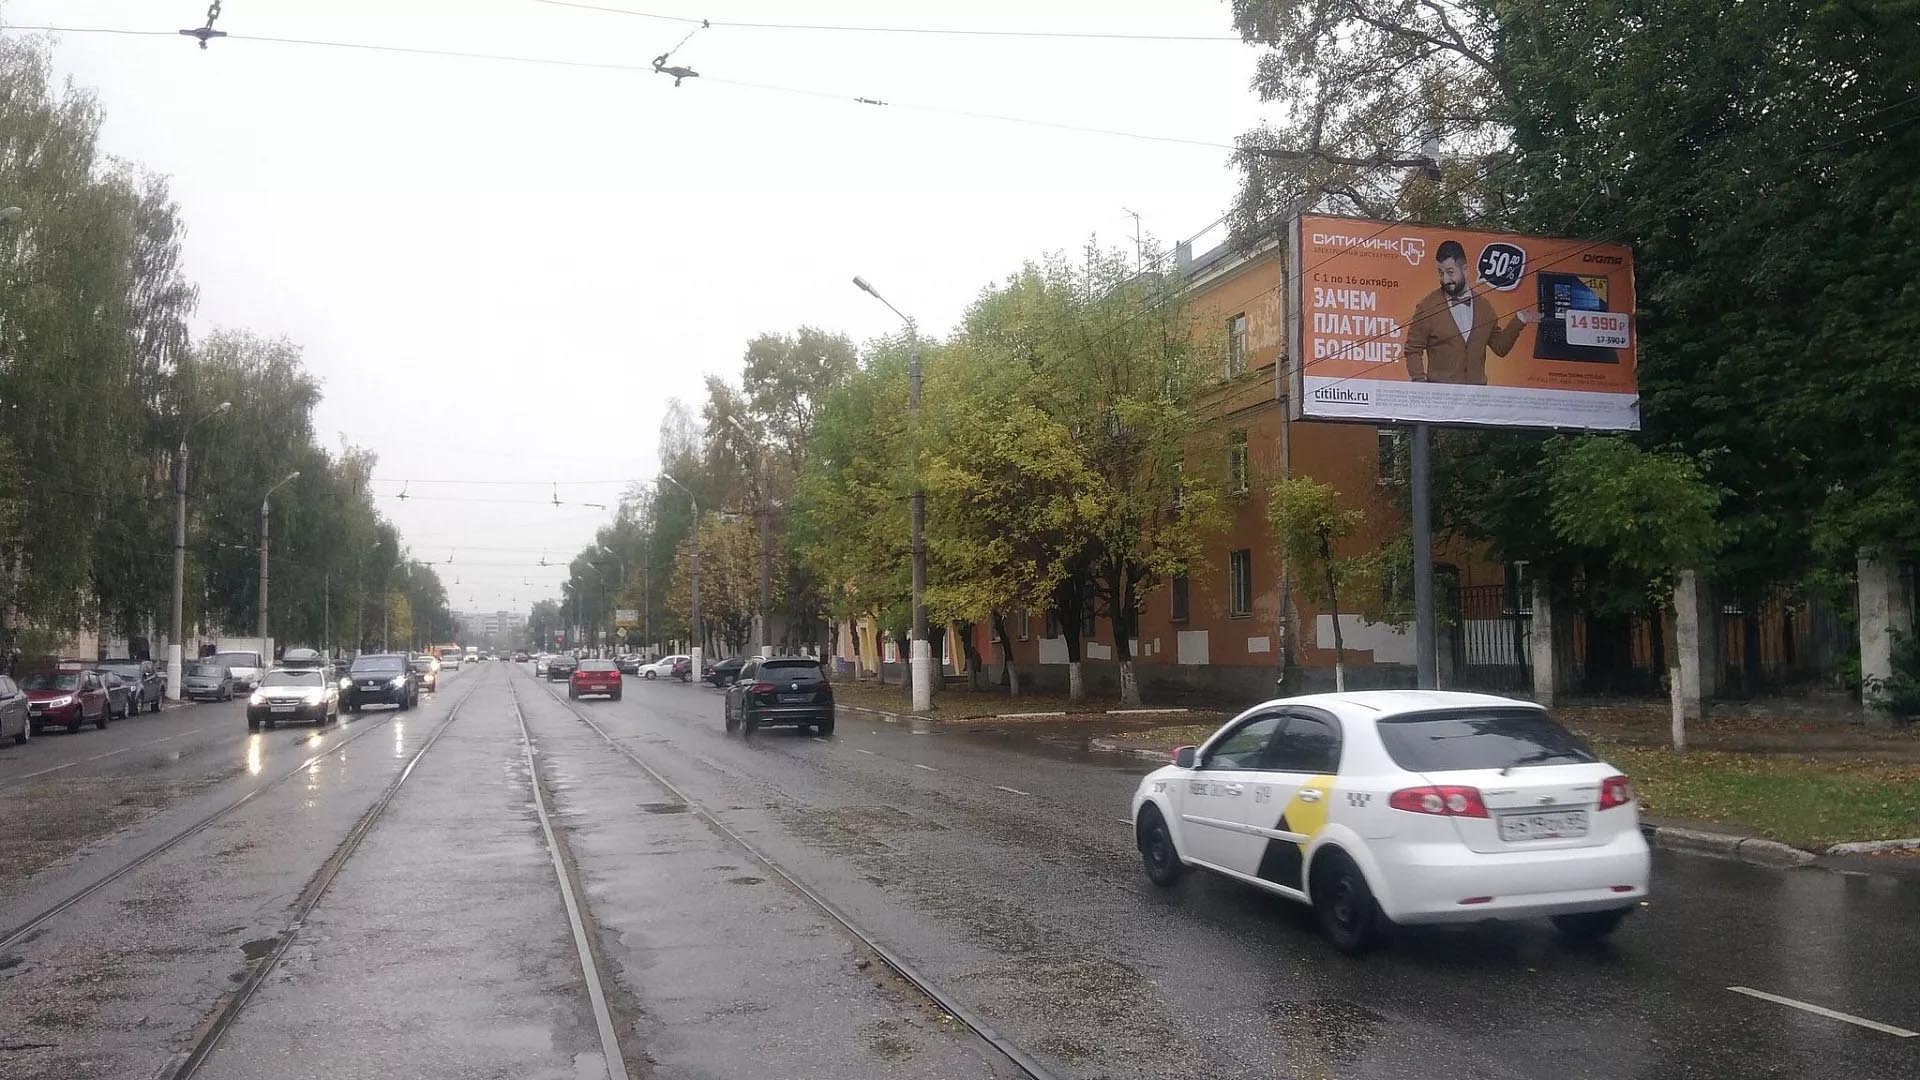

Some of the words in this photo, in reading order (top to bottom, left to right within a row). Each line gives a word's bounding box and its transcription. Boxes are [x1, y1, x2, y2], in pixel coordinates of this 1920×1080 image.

[1312, 233, 1399, 251] СИТИЛИНК
[1582, 253, 1623, 265] DIGMA
[1313, 273, 1321, 282] С
[1323, 274, 1328, 283] 1
[1331, 275, 1343, 284] по
[1346, 275, 1358, 285] 16
[1359, 277, 1399, 290] октября
[1313, 287, 1377, 311] ЗАЧЕМ
[1313, 312, 1401, 338] ПЛАТИТЬ
[1314, 338, 1402, 363] БОЛЬШЕ?
[1314, 387, 1370, 402] citilink.ru
